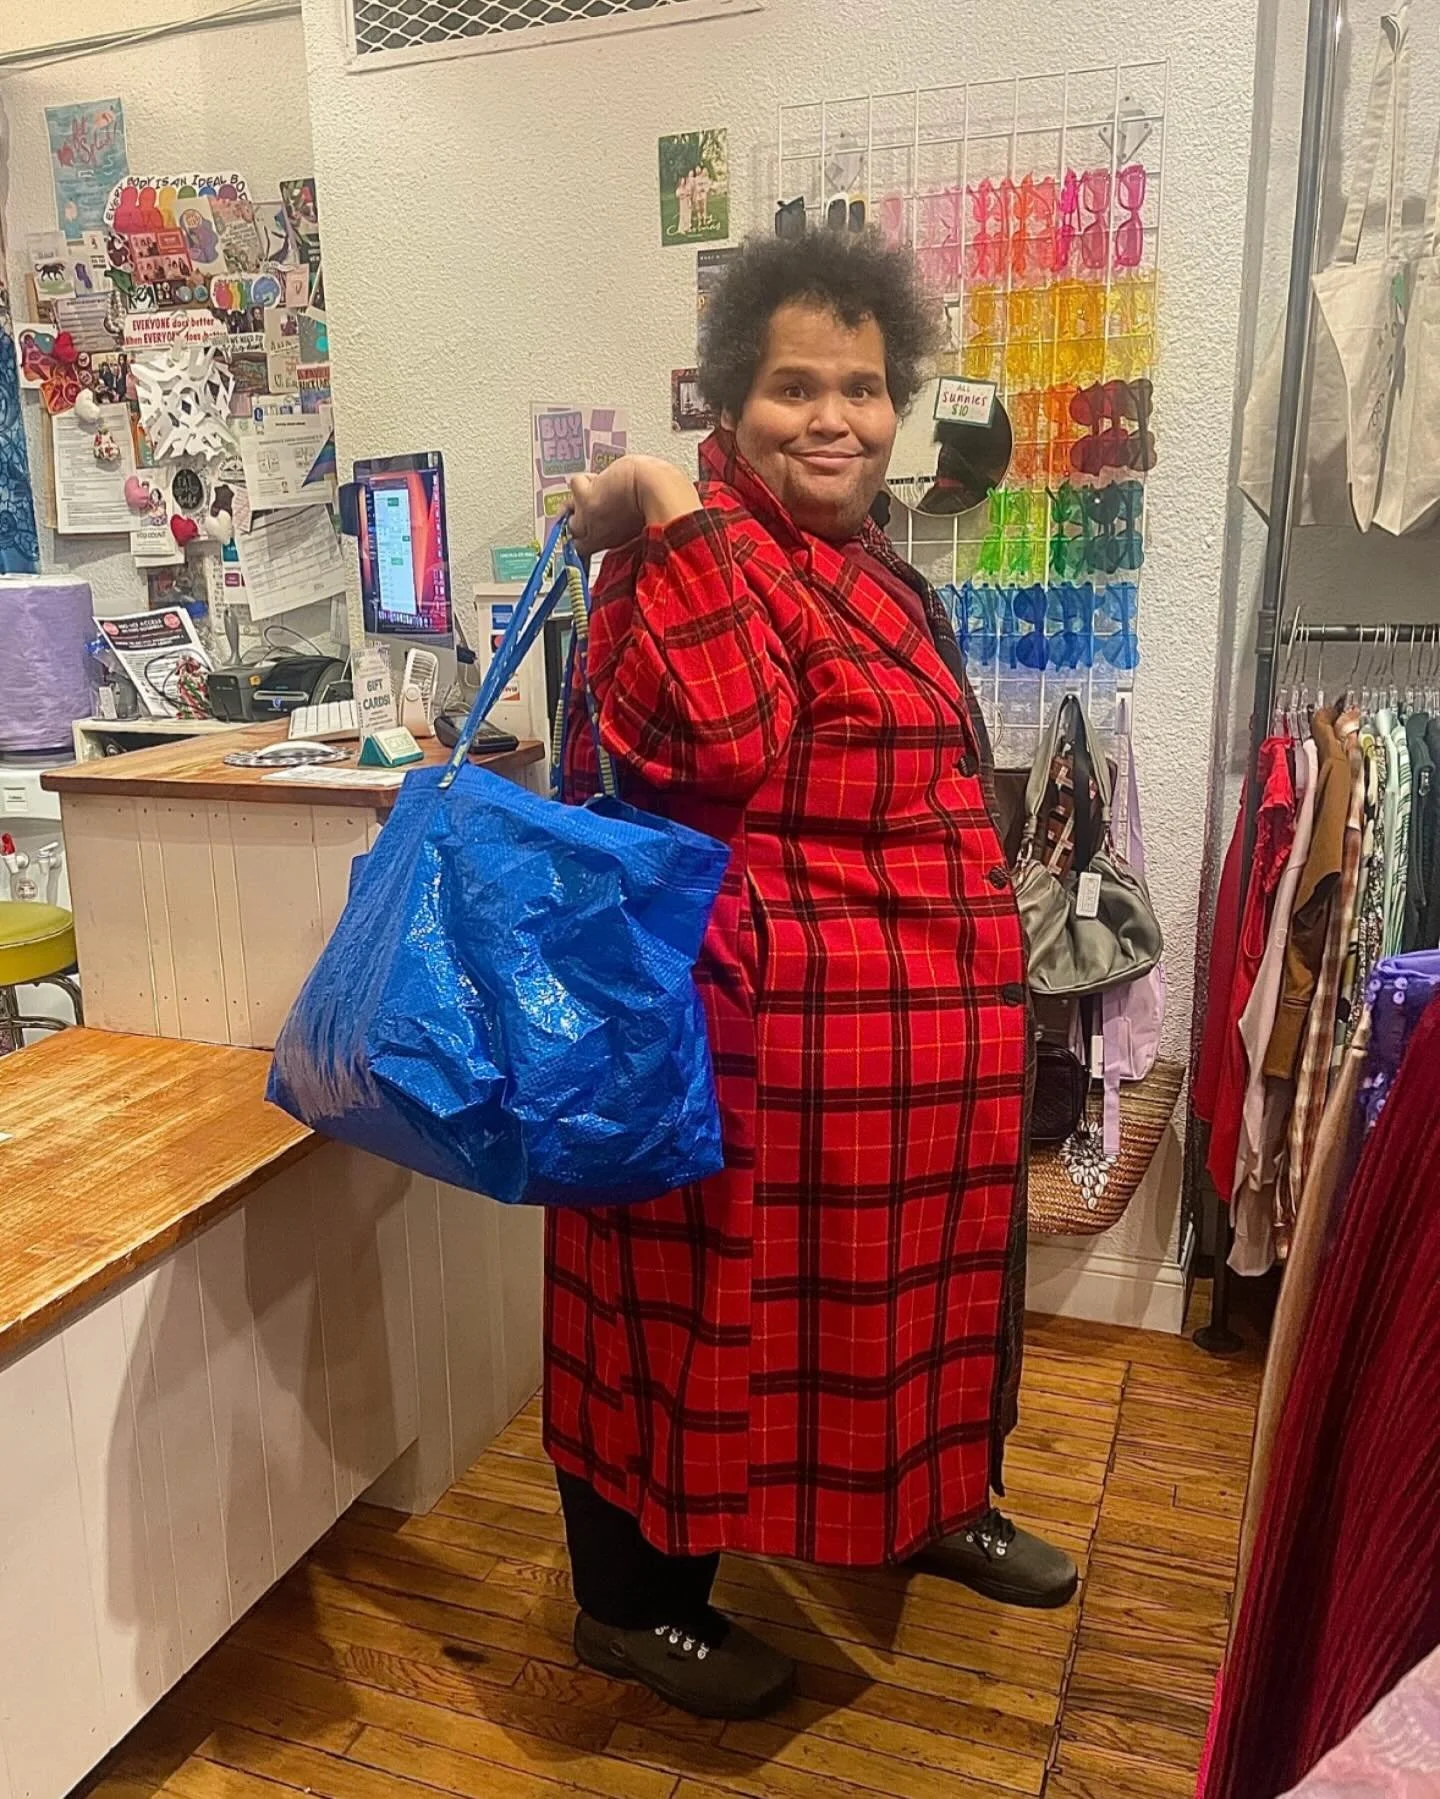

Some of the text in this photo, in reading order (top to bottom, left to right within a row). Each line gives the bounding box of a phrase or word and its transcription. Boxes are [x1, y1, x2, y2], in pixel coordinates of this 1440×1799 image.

[155, 176, 170, 190] IS
[170, 177, 188, 187] AN
[191, 174, 227, 187] IDEAL
[132, 317, 170, 331] EVERYONE
[190, 316, 215, 327] better
[143, 331, 180, 344] EVERYO
[957, 383, 971, 392] ALL
[951, 403, 969, 416] $10
[541, 415, 582, 439] BUY
[543, 437, 584, 461] FAT
[366, 679, 383, 692] GIFT
